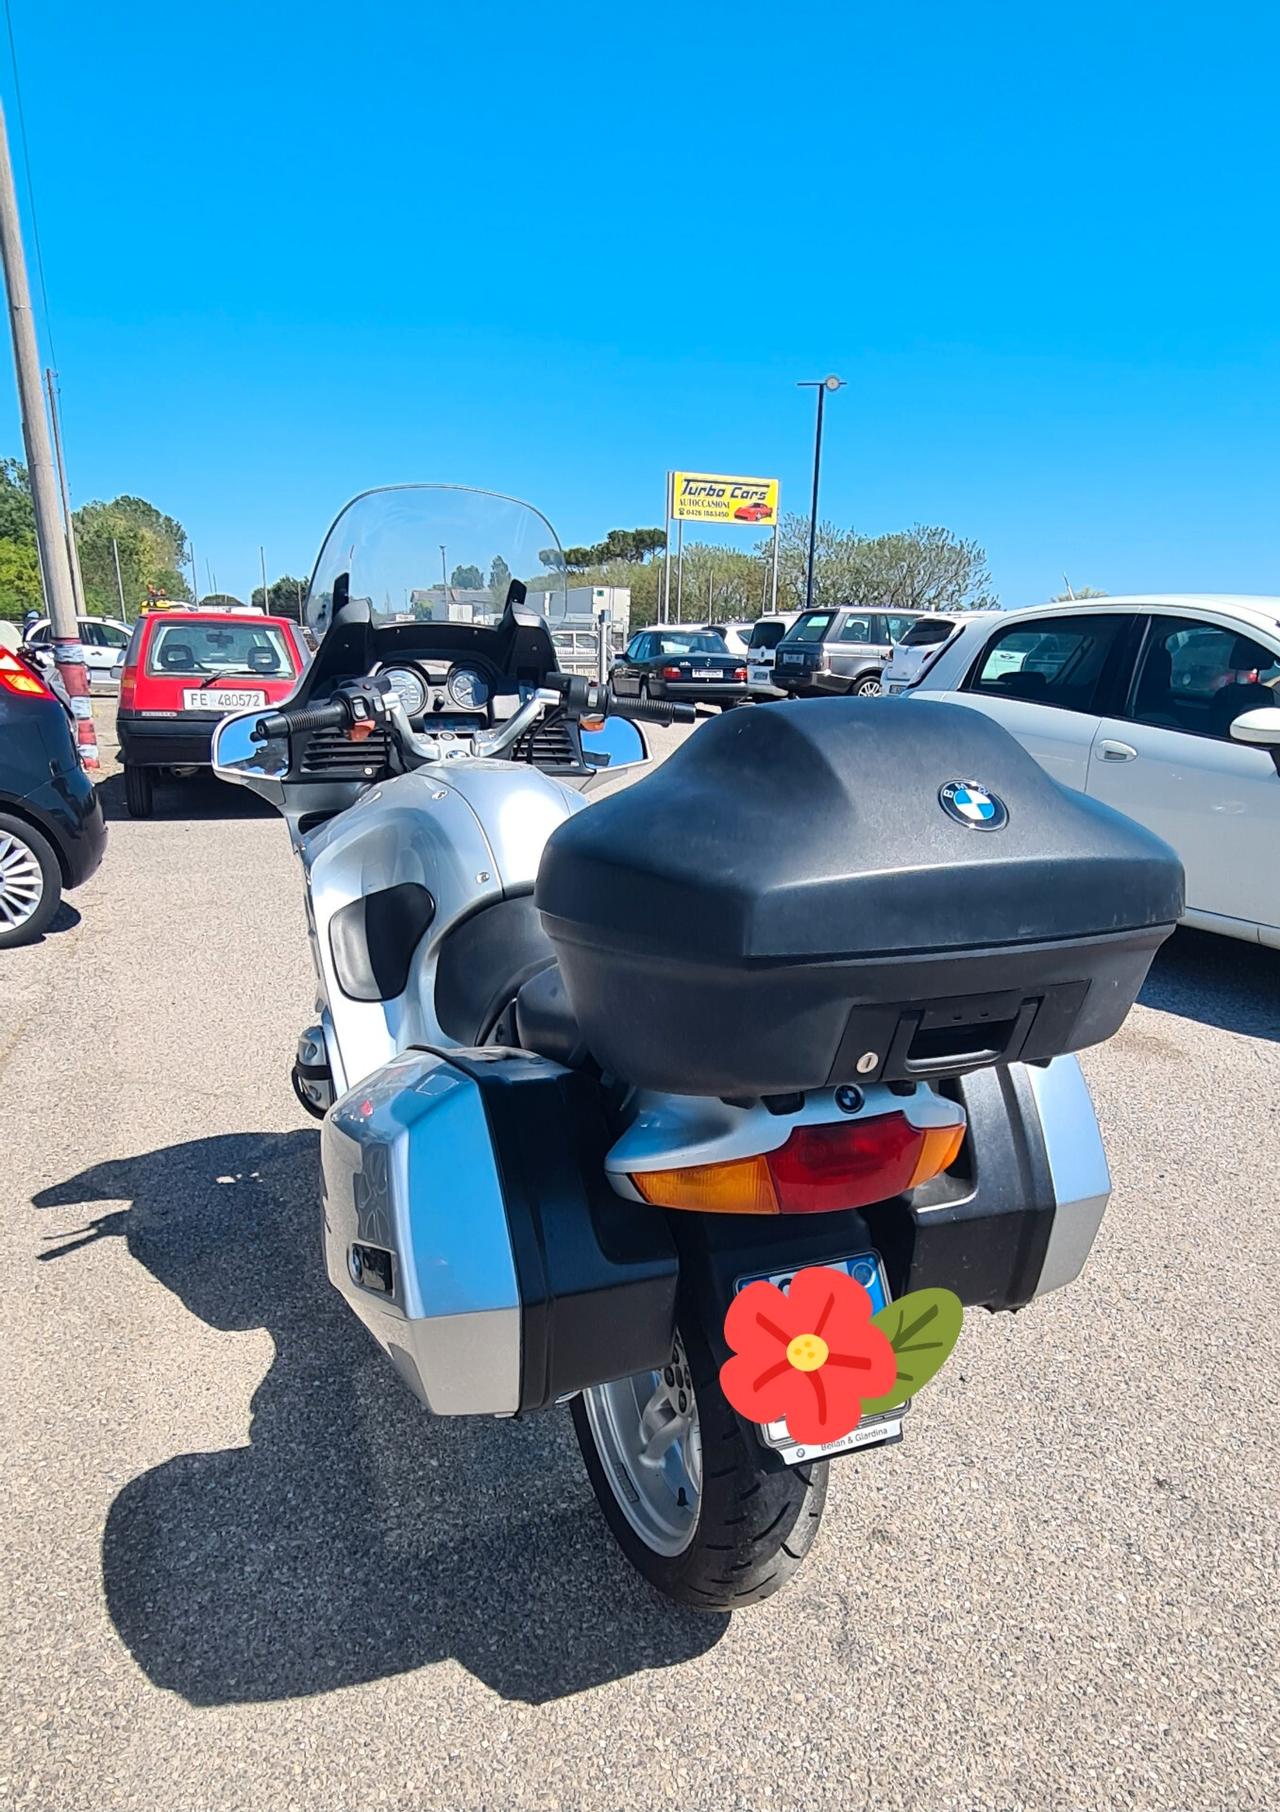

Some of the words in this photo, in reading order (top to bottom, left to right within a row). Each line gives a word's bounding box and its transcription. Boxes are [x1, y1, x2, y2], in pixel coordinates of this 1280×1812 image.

[681, 479, 725, 497] Turbo
[730, 486, 768, 500] Cars
[190, 693, 208, 706] FE
[218, 694, 260, 707] 480572
[847, 1436, 854, 1445] &
[854, 1428, 888, 1442] Giardina
